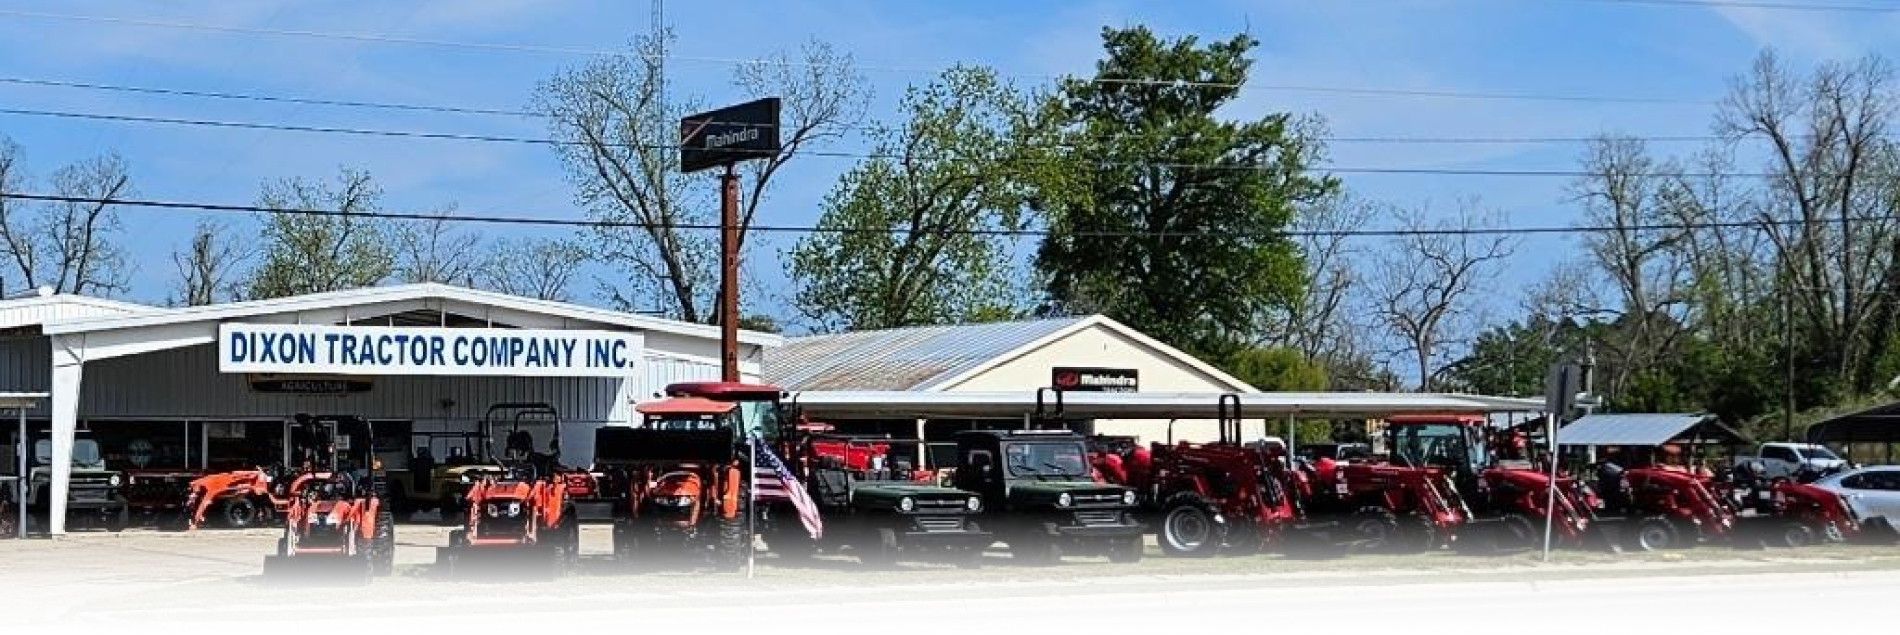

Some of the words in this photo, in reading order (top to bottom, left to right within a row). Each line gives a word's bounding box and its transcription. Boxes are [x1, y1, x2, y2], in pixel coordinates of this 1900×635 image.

[706, 126, 758, 148] Mahindra
[230, 331, 317, 364] DIXON
[324, 333, 446, 367] TRACTOR
[453, 335, 578, 368] COMPANY
[585, 338, 635, 369] INC.
[1080, 373, 1137, 386] Mahindra
